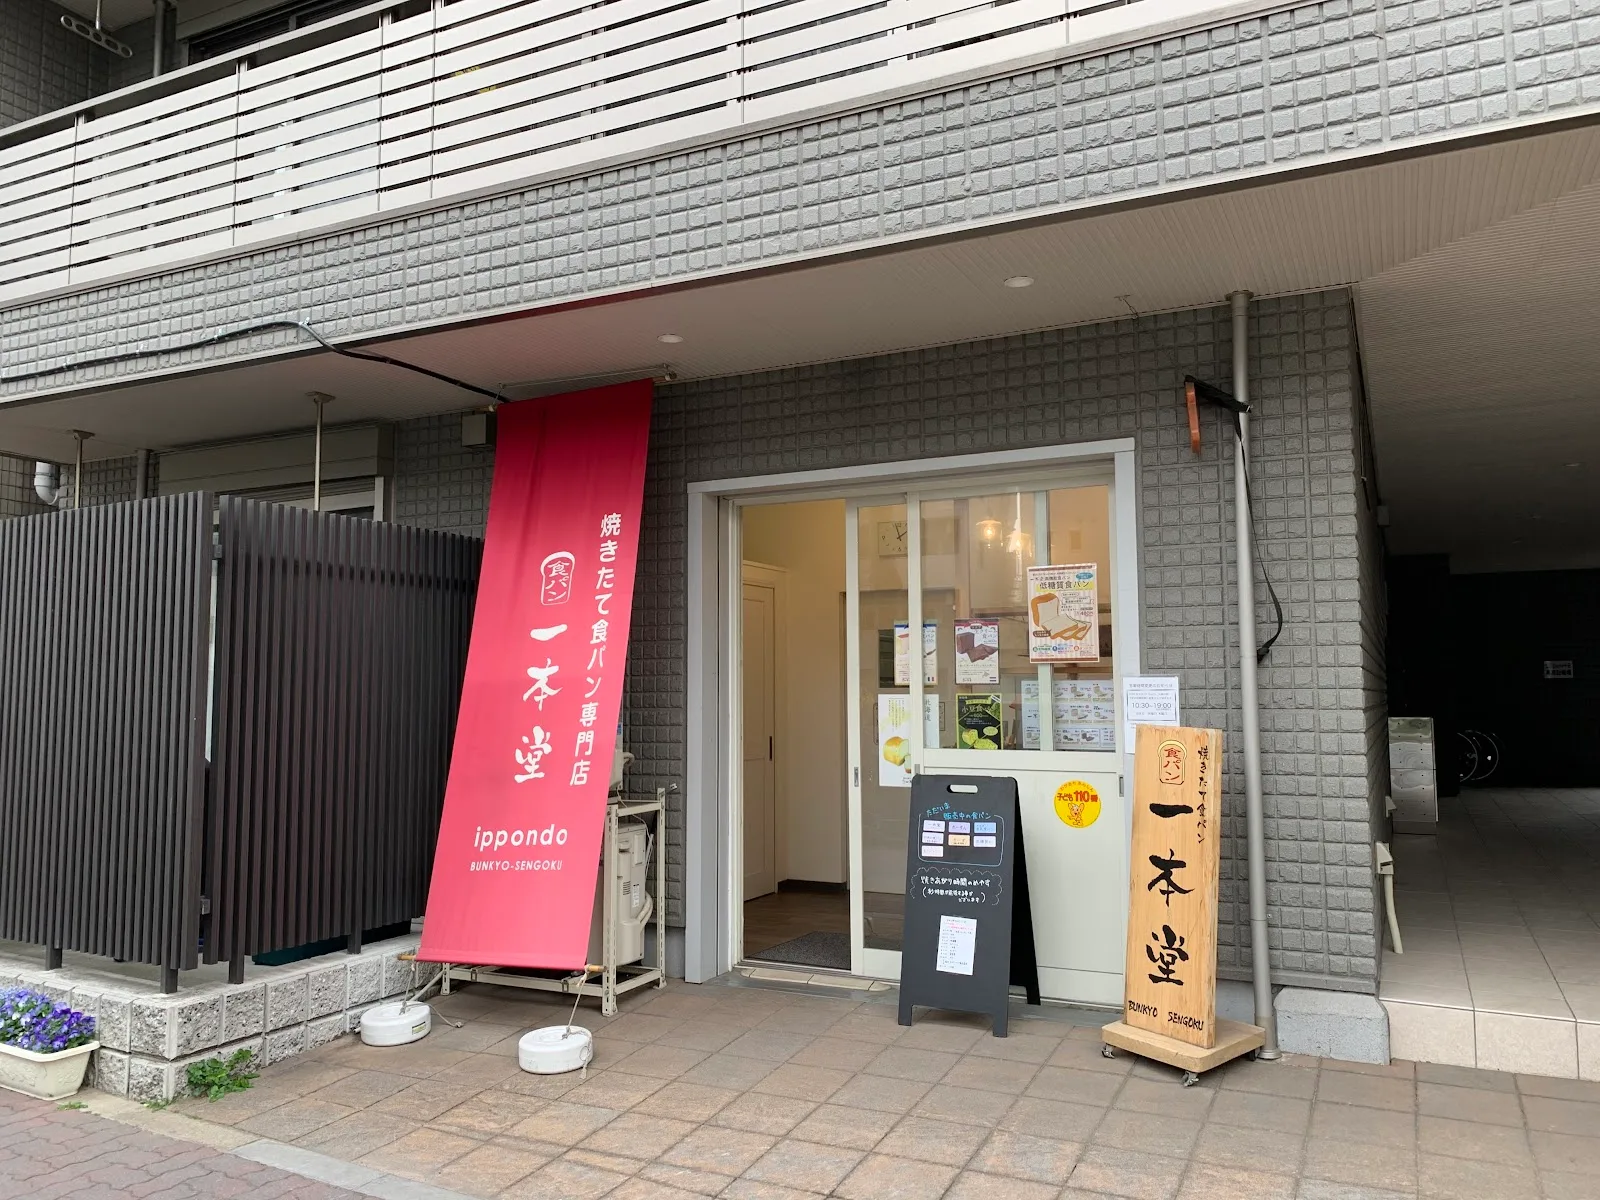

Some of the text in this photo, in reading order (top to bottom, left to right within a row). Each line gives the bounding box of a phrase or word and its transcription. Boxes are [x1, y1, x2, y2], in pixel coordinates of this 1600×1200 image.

[545, 560, 570, 602] 食パン
[1040, 580, 1089, 590] 低糖質食パン
[569, 512, 622, 787] 焼きたて食パン専門店
[514, 623, 568, 784] 一本堂
[1163, 747, 1182, 781] 食パン
[926, 802, 951, 817] ただいま
[1196, 745, 1209, 844] 焼きたて食パン
[943, 811, 991, 820] 販売中の食パン
[474, 823, 568, 852] ippondo
[470, 859, 563, 872] BUNKYO-SENGOKU
[920, 875, 990, 887] 焼きあがり時間のめやす
[1145, 802, 1196, 987] 一本堂
[1128, 1000, 1204, 1031] BUNKYO SENGOKU
